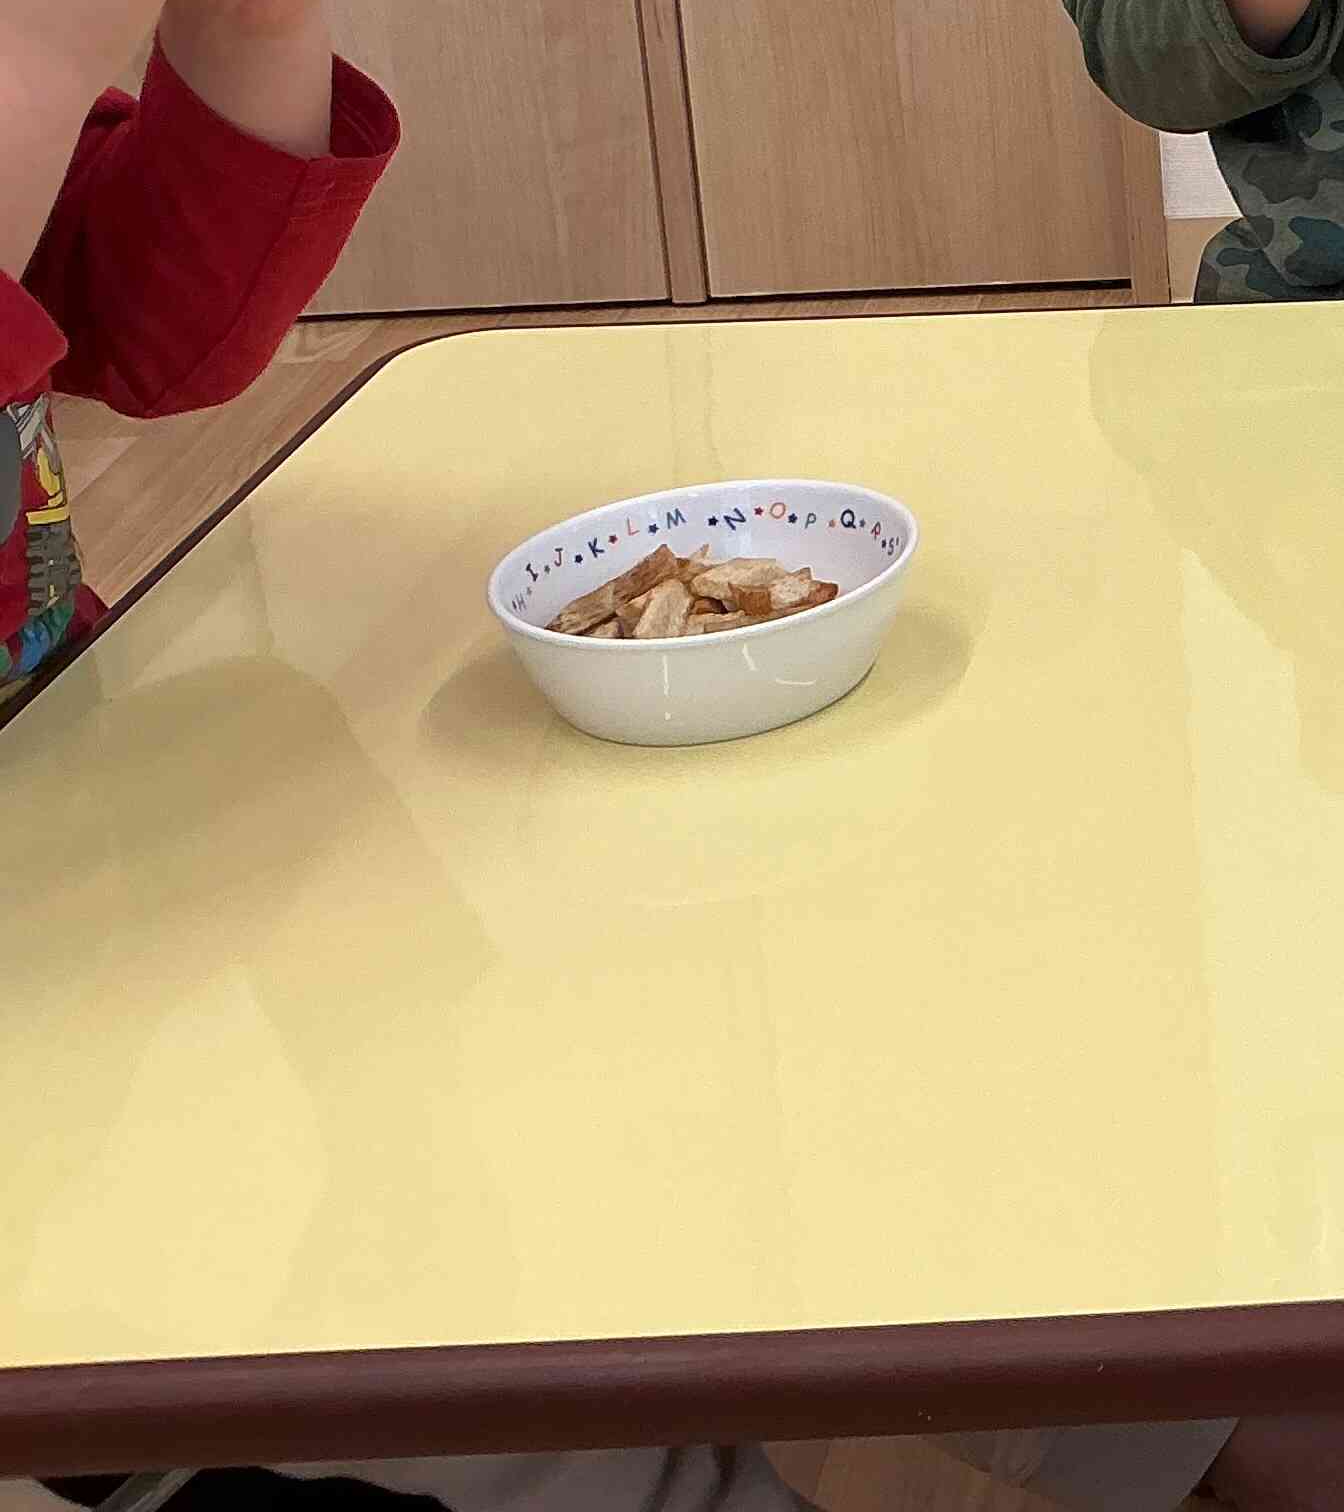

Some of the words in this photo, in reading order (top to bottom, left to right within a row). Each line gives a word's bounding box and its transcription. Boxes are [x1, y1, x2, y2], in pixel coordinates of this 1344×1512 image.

[554, 547, 563, 567] J
[588, 537, 605, 558] K
[626, 517, 640, 536] L
[666, 508, 686, 530] M
[724, 508, 746, 530] N
[770, 502, 786, 519] O
[805, 514, 816, 529] P
[840, 509, 856, 529] Q
